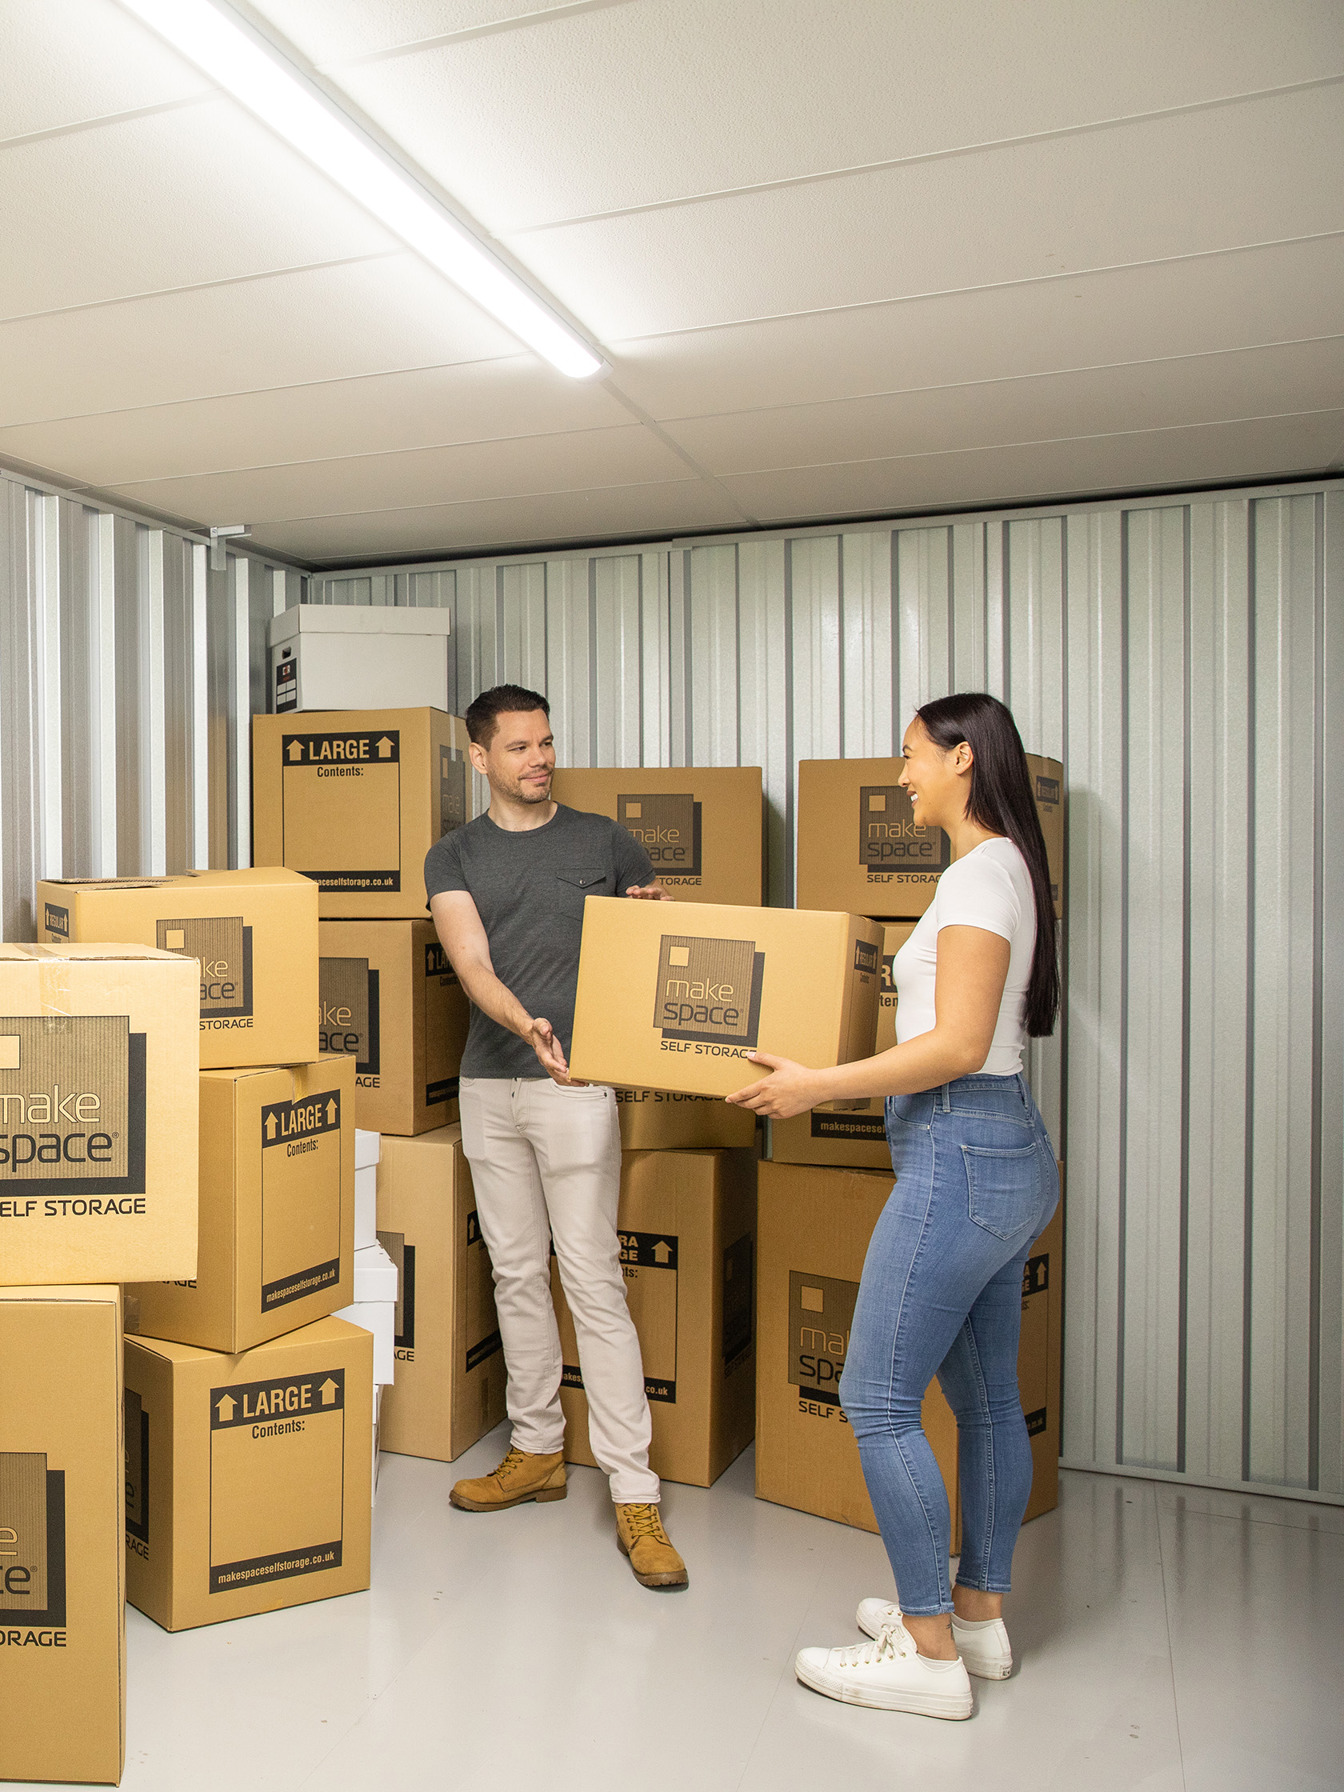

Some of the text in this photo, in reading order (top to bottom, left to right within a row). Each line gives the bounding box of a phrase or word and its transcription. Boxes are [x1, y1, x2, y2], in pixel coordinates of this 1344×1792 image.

[309, 739, 370, 760] LARGE
[317, 766, 364, 777] Contents:
[868, 819, 927, 837] make
[645, 847, 685, 861] ace
[867, 842, 933, 861] space
[315, 876, 394, 888] aceselfstorage.co.uk
[657, 877, 702, 885] TORAGE
[867, 874, 894, 883] SELF
[200, 956, 229, 978] ke
[200, 982, 235, 1001] ace
[665, 977, 734, 1002] make
[663, 1002, 739, 1026] space
[199, 1018, 254, 1031] STORAGE
[319, 1031, 359, 1053] ace
[660, 1040, 691, 1053] SELF
[616, 1090, 650, 1102] SELF
[281, 1103, 322, 1136] LARGE
[287, 1138, 319, 1157] Contents:
[44, 1198, 146, 1216] STORAGE
[266, 1268, 336, 1303] makespaceselfstorage.co.uk
[242, 1383, 312, 1418] LARGE
[798, 1400, 835, 1419] SELF
[251, 1420, 305, 1439] Contents:
[125, 1534, 150, 1560] RAGE
[218, 1551, 335, 1584] makespaceselfstorage.co.uk
